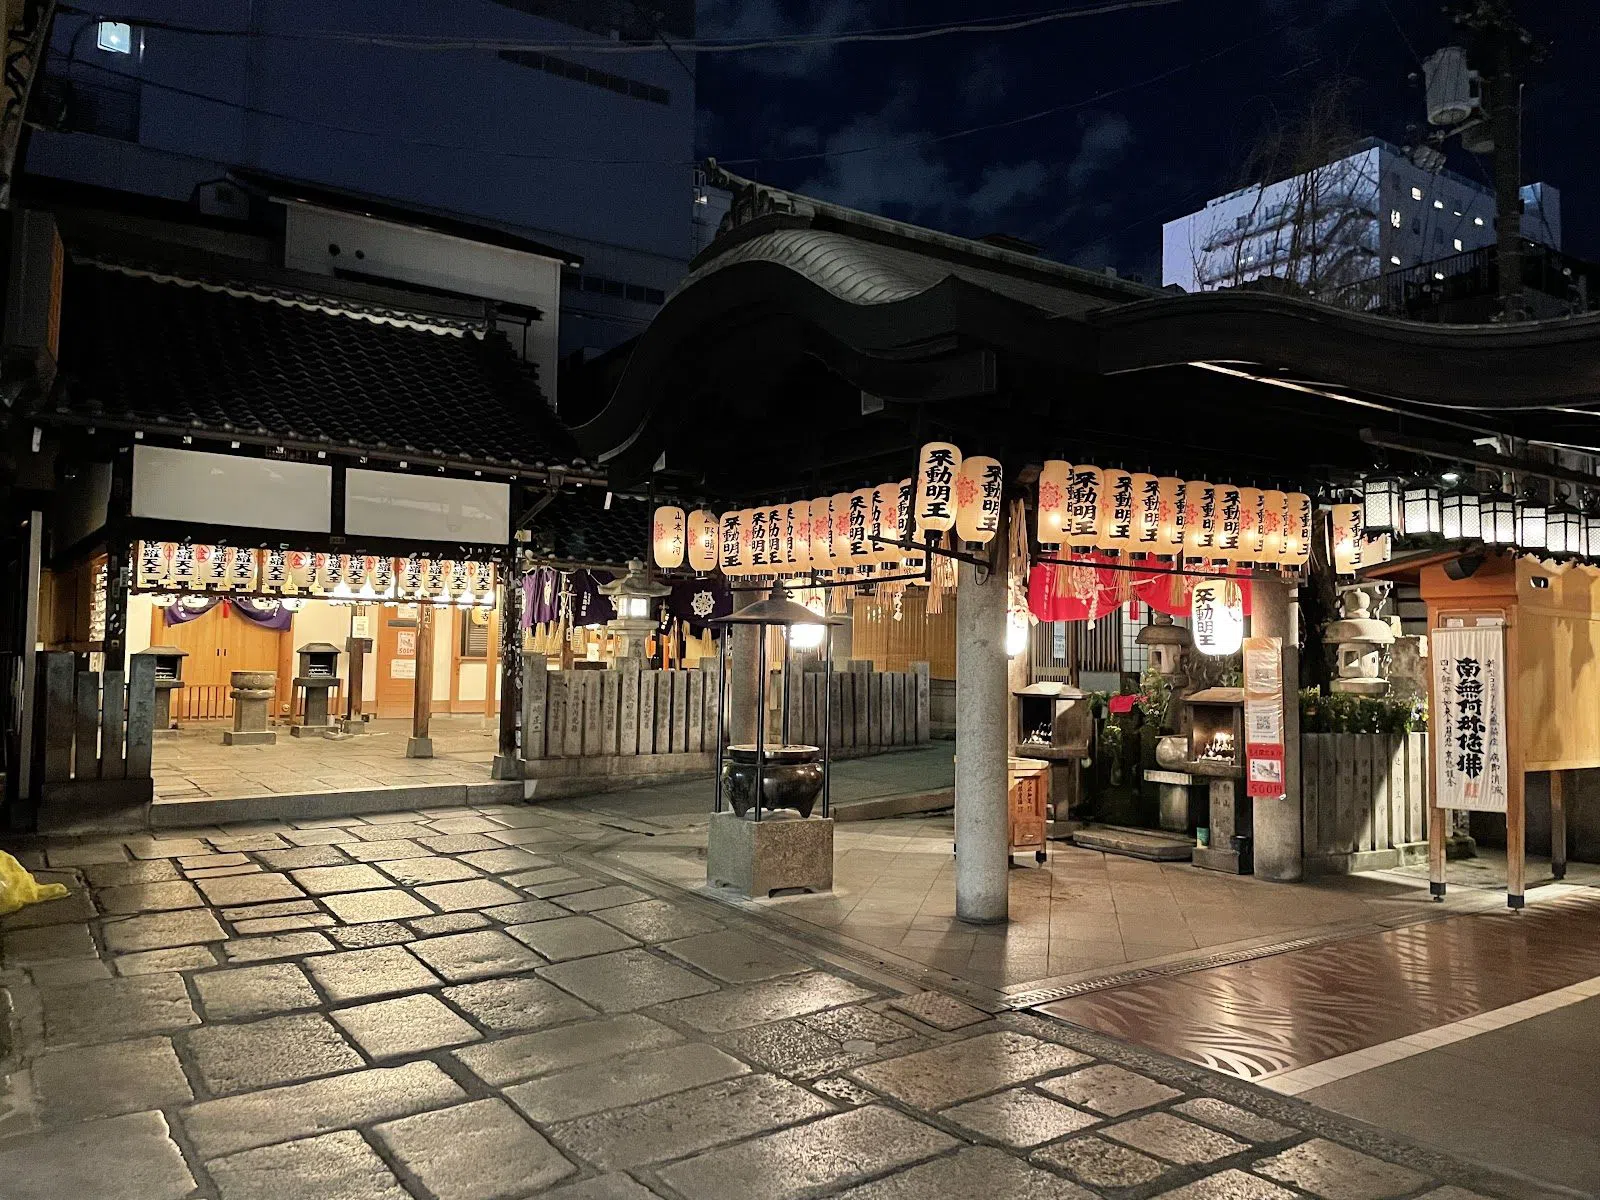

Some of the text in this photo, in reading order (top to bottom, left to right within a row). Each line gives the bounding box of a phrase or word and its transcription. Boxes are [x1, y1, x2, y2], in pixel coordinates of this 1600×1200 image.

[921, 449, 957, 520] 不動明王
[1071, 471, 1100, 537] 不動明王
[721, 515, 743, 569] 不動明王
[1195, 588, 1217, 646] 不動明王
